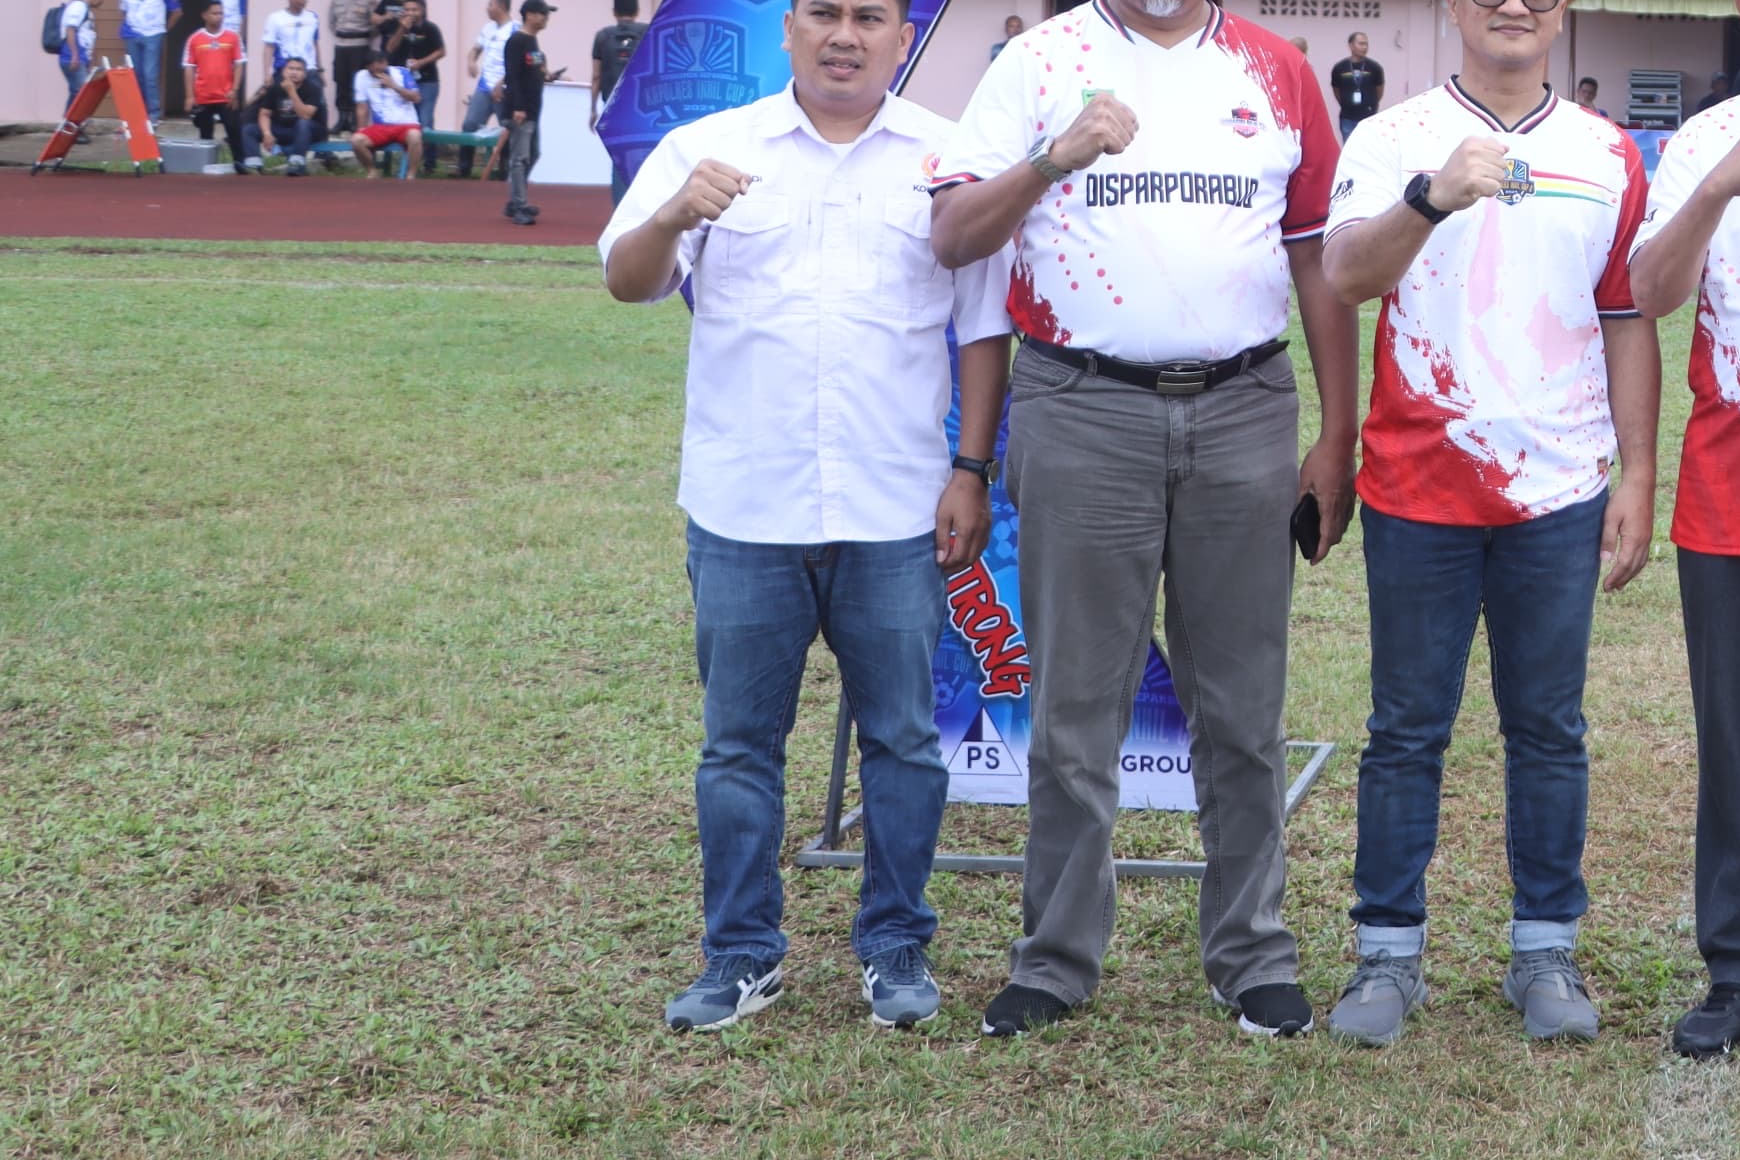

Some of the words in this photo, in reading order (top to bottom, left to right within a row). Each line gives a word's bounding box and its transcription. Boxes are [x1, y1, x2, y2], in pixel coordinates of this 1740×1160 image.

[946, 554, 1031, 697] TRONG
[967, 746, 1000, 769] PS
[1121, 754, 1192, 774] GROU
